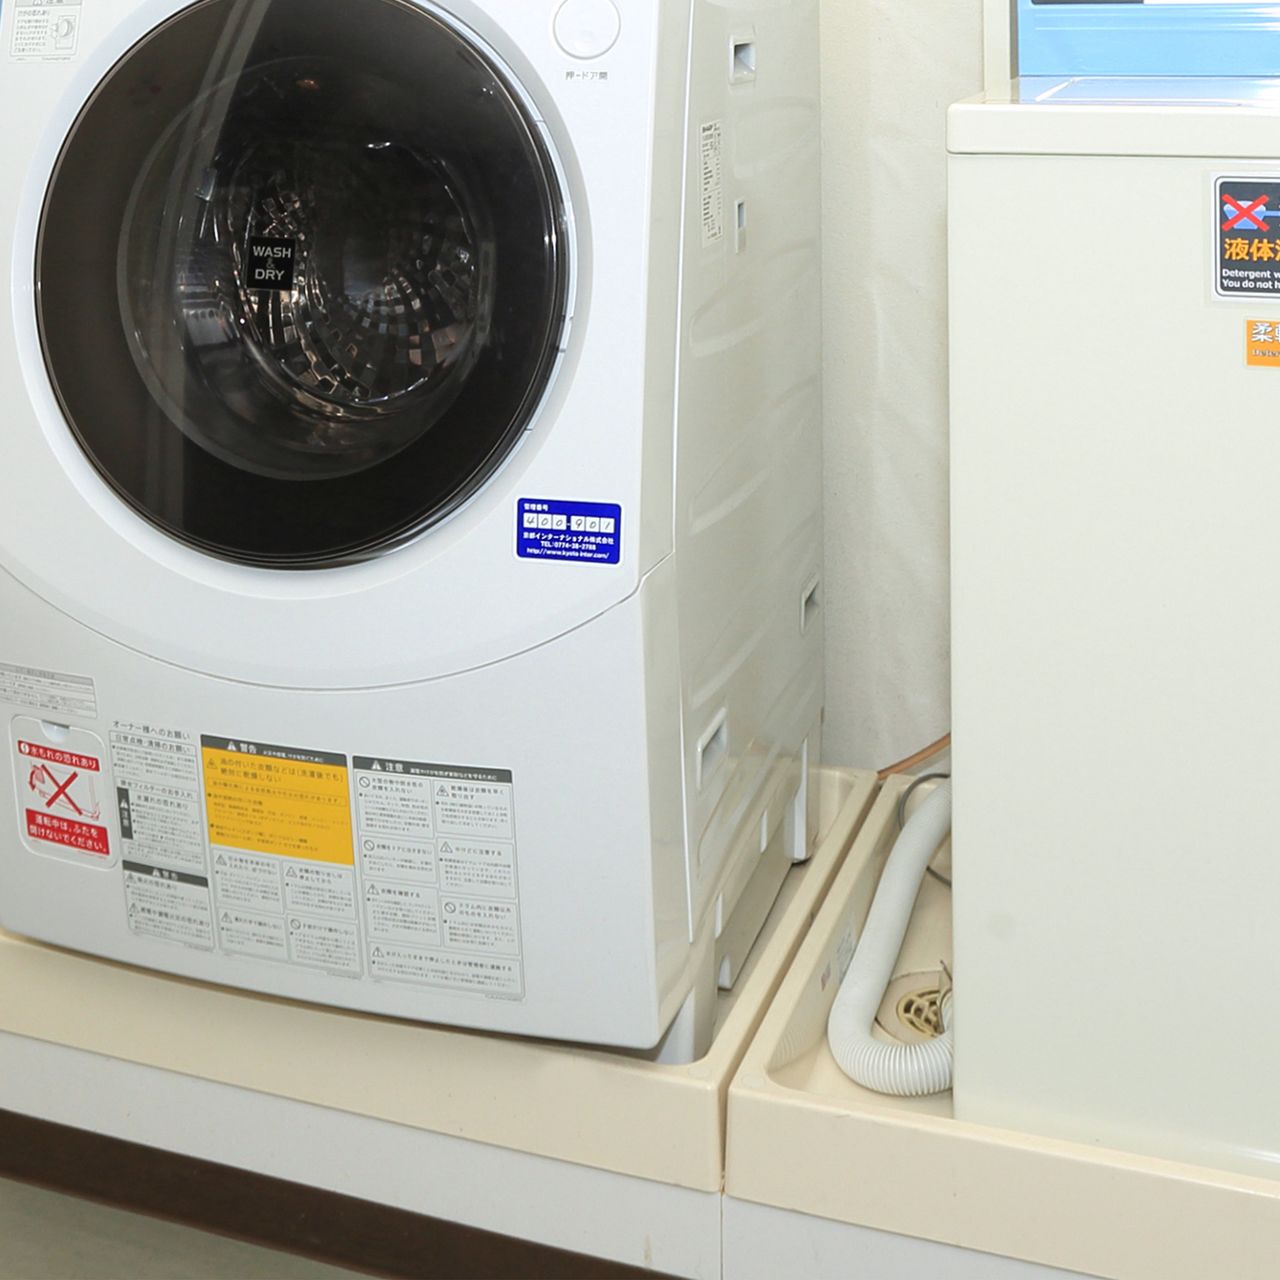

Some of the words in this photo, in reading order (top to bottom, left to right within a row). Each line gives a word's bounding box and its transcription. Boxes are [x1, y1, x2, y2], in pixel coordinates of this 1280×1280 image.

[253, 245, 291, 258] WASH
[254, 269, 285, 280] DRY
[1222, 268, 1271, 281] Detergent
[1222, 279, 1240, 289] You
[1242, 280, 1255, 289] do
[1256, 280, 1273, 290] not
[523, 532, 614, 545] 京都インターナショナル株式会社
[112, 720, 191, 740] オーナー様へのお願い
[240, 742, 257, 754] 警告
[30, 747, 97, 769] 水もれの恐れあり
[385, 762, 404, 773] 注意
[34, 814, 99, 839] 運転中は、ふたを
[29, 824, 108, 853] 開けないでください。
